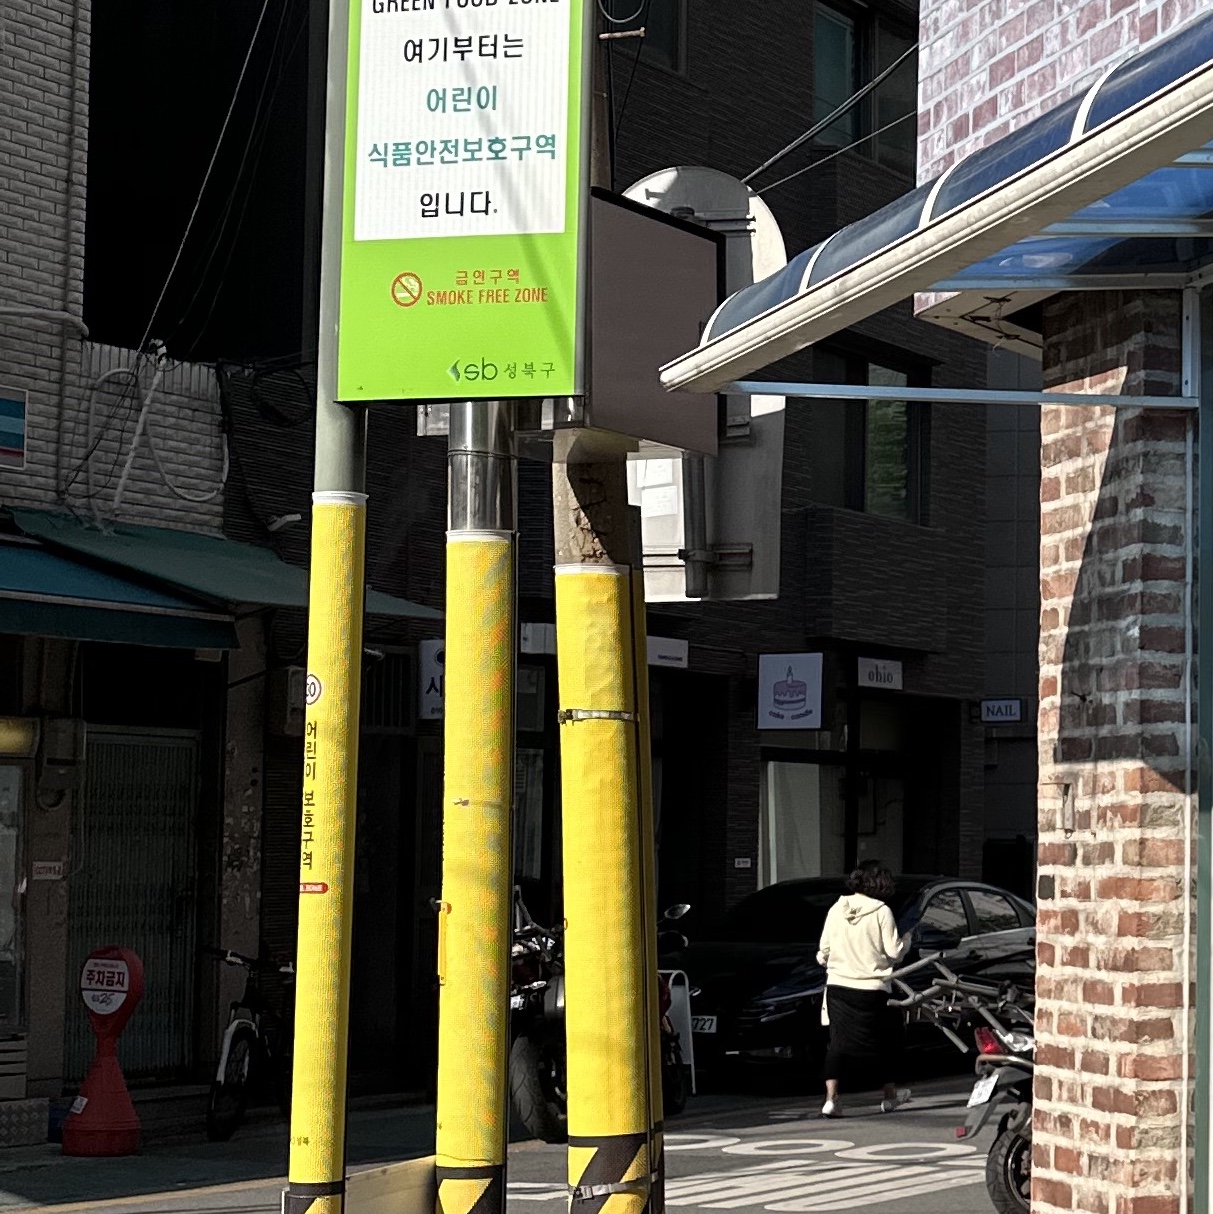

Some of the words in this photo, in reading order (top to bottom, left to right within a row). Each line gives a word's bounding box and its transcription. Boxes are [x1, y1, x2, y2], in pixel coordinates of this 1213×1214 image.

[403, 33, 524, 64] 여기부터는
[426, 85, 497, 114] 어린이
[367, 133, 556, 168] 식품안전보호구역
[419, 190, 498, 218] 입니다.
[427, 289, 474, 306] SMOKE
[478, 288, 511, 304] FREE
[514, 286, 549, 303] ZONE
[503, 361, 556, 381] 성북구
[868, 664, 894, 684] ohio
[986, 704, 1016, 717] NAIL
[305, 720, 318, 781] 어린이
[302, 789, 316, 871] 보호구역
[86, 969, 126, 988] 주차금지
